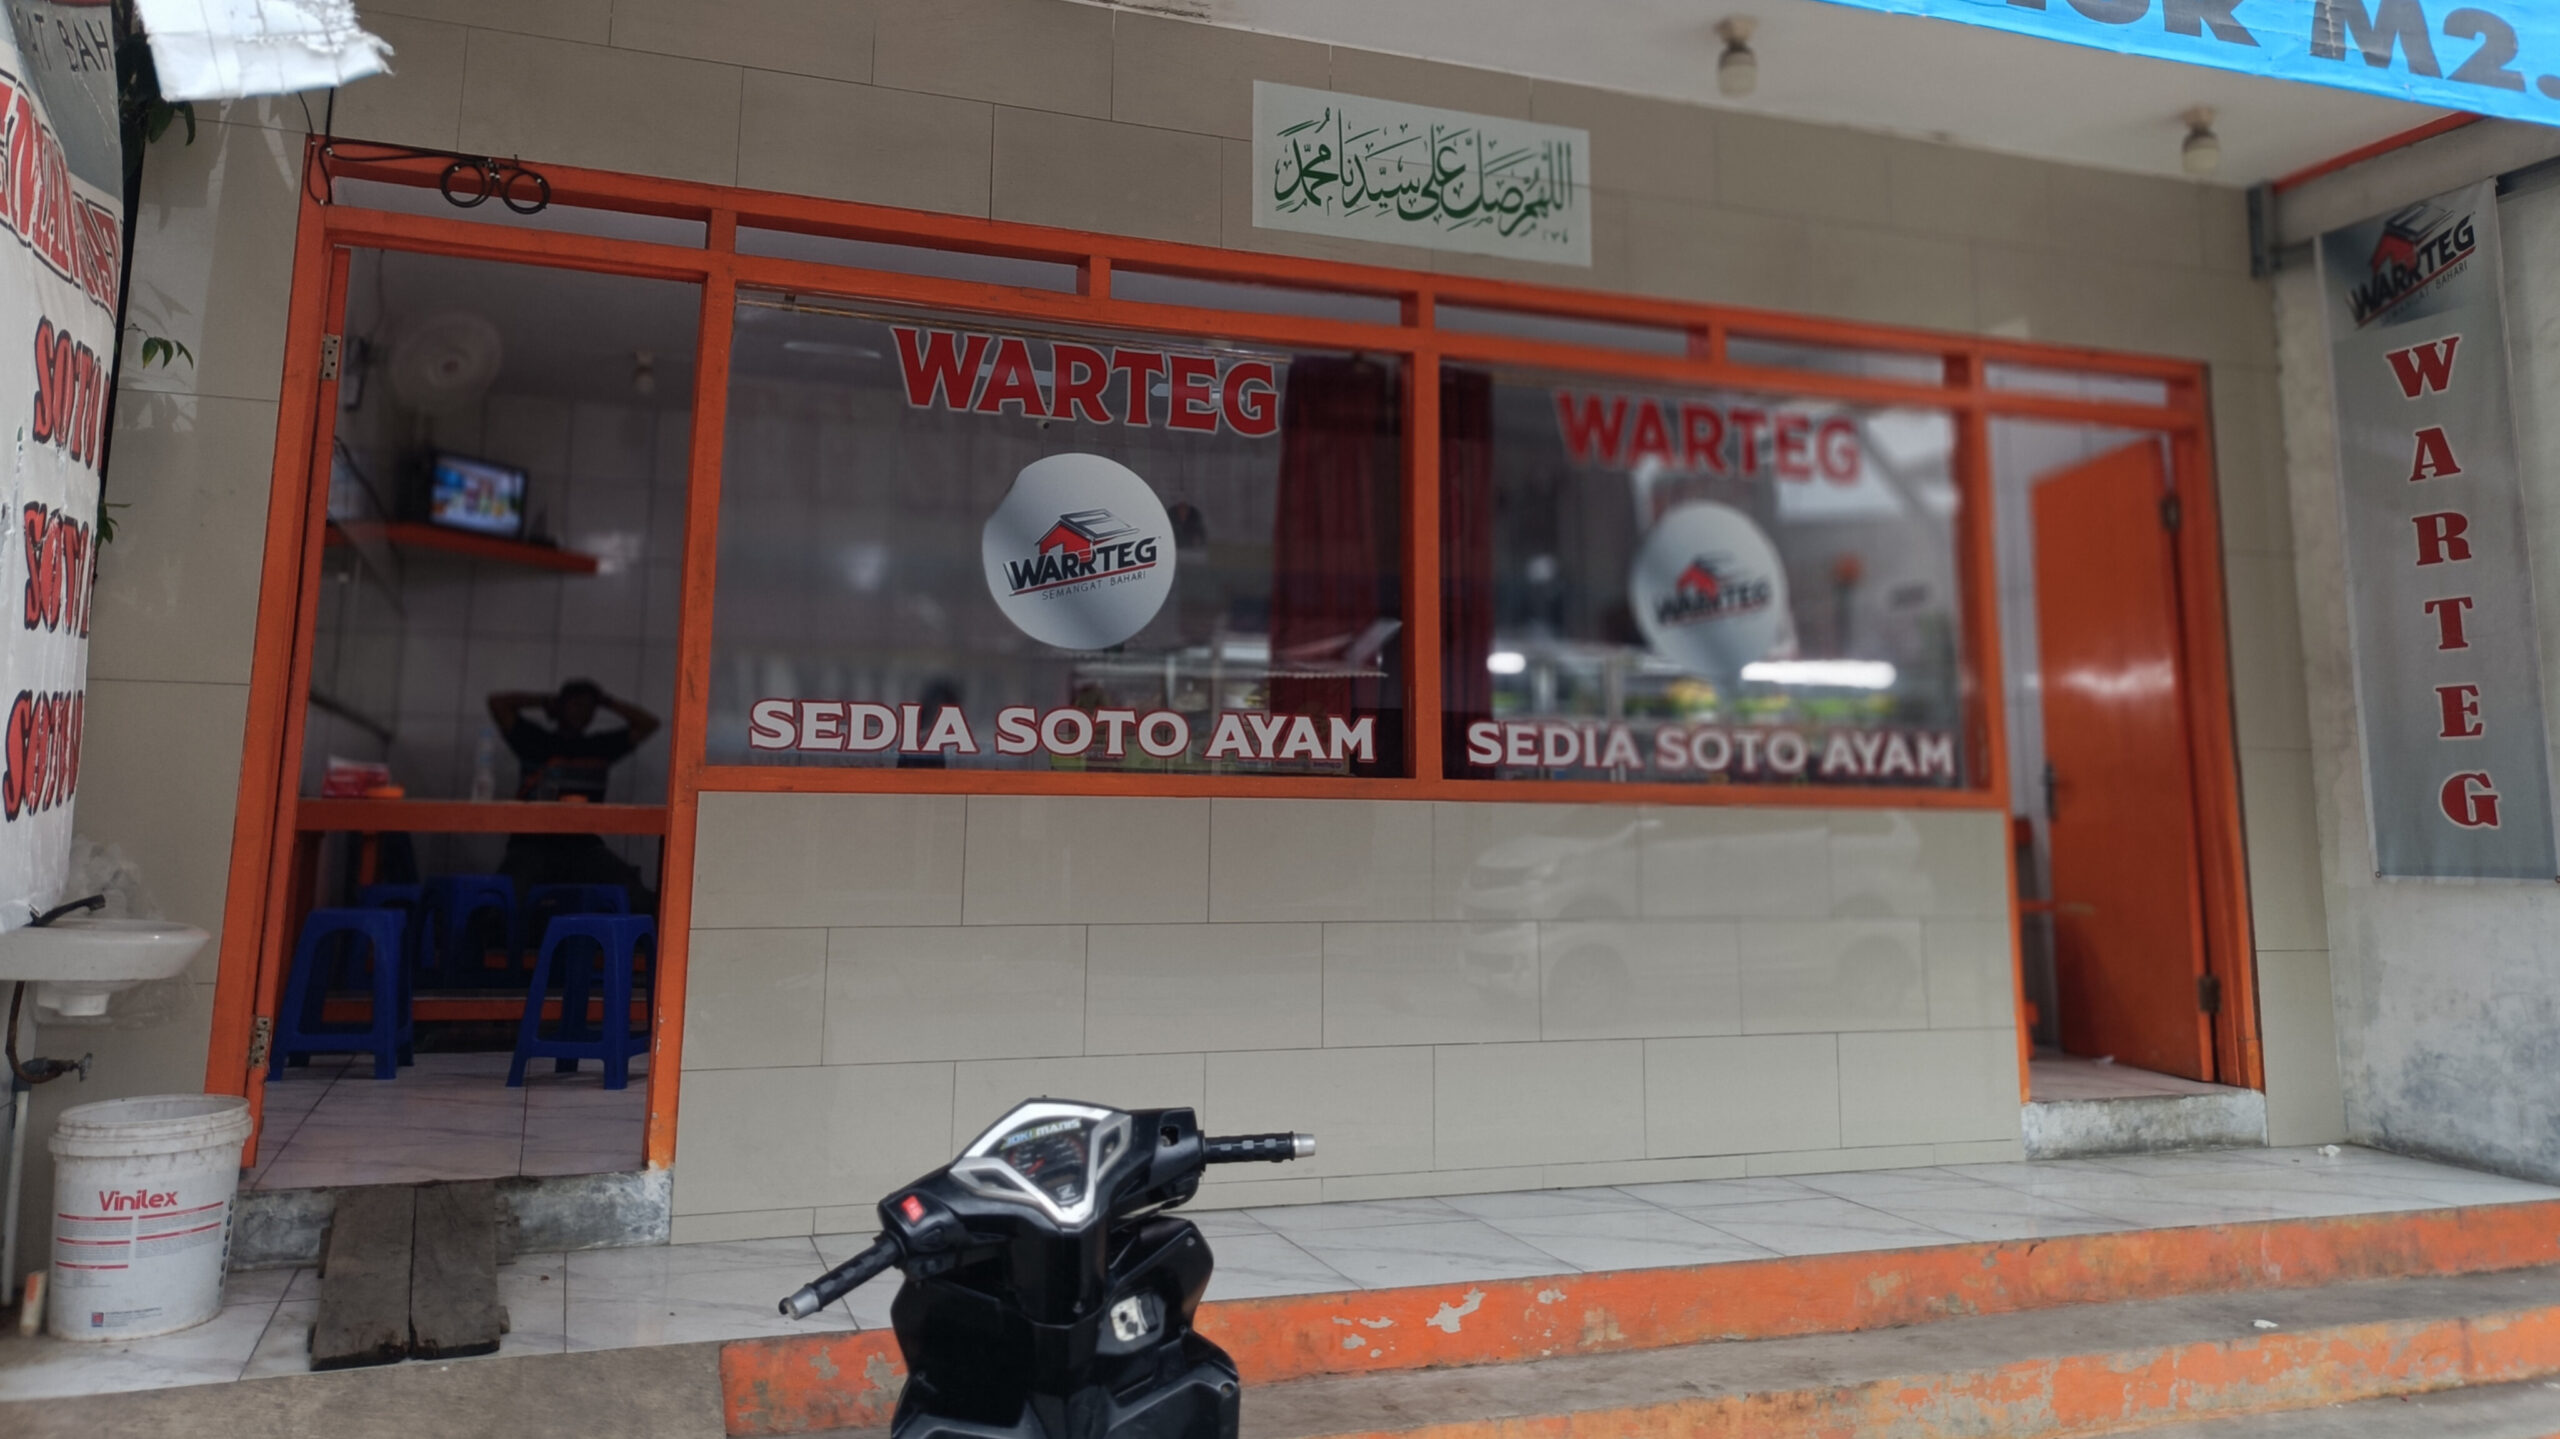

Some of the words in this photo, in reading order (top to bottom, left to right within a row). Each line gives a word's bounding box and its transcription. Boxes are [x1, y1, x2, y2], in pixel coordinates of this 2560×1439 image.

[891, 326, 1279, 438] WARTEG
[1557, 391, 1861, 486] WARTEG
[1042, 579, 1102, 601] SEMANGAT
[1110, 570, 1147, 587] BAHARI
[2386, 336, 2500, 829] WARTEG
[750, 699, 980, 754] SEDIA
[995, 705, 1191, 758] SOTO
[1203, 710, 1377, 763] AYAM
[1466, 720, 1643, 771] SEDIA
[1654, 725, 1807, 775] SOTO
[1818, 731, 1957, 778] AYAM
[99, 1189, 178, 1212] Vinilex
